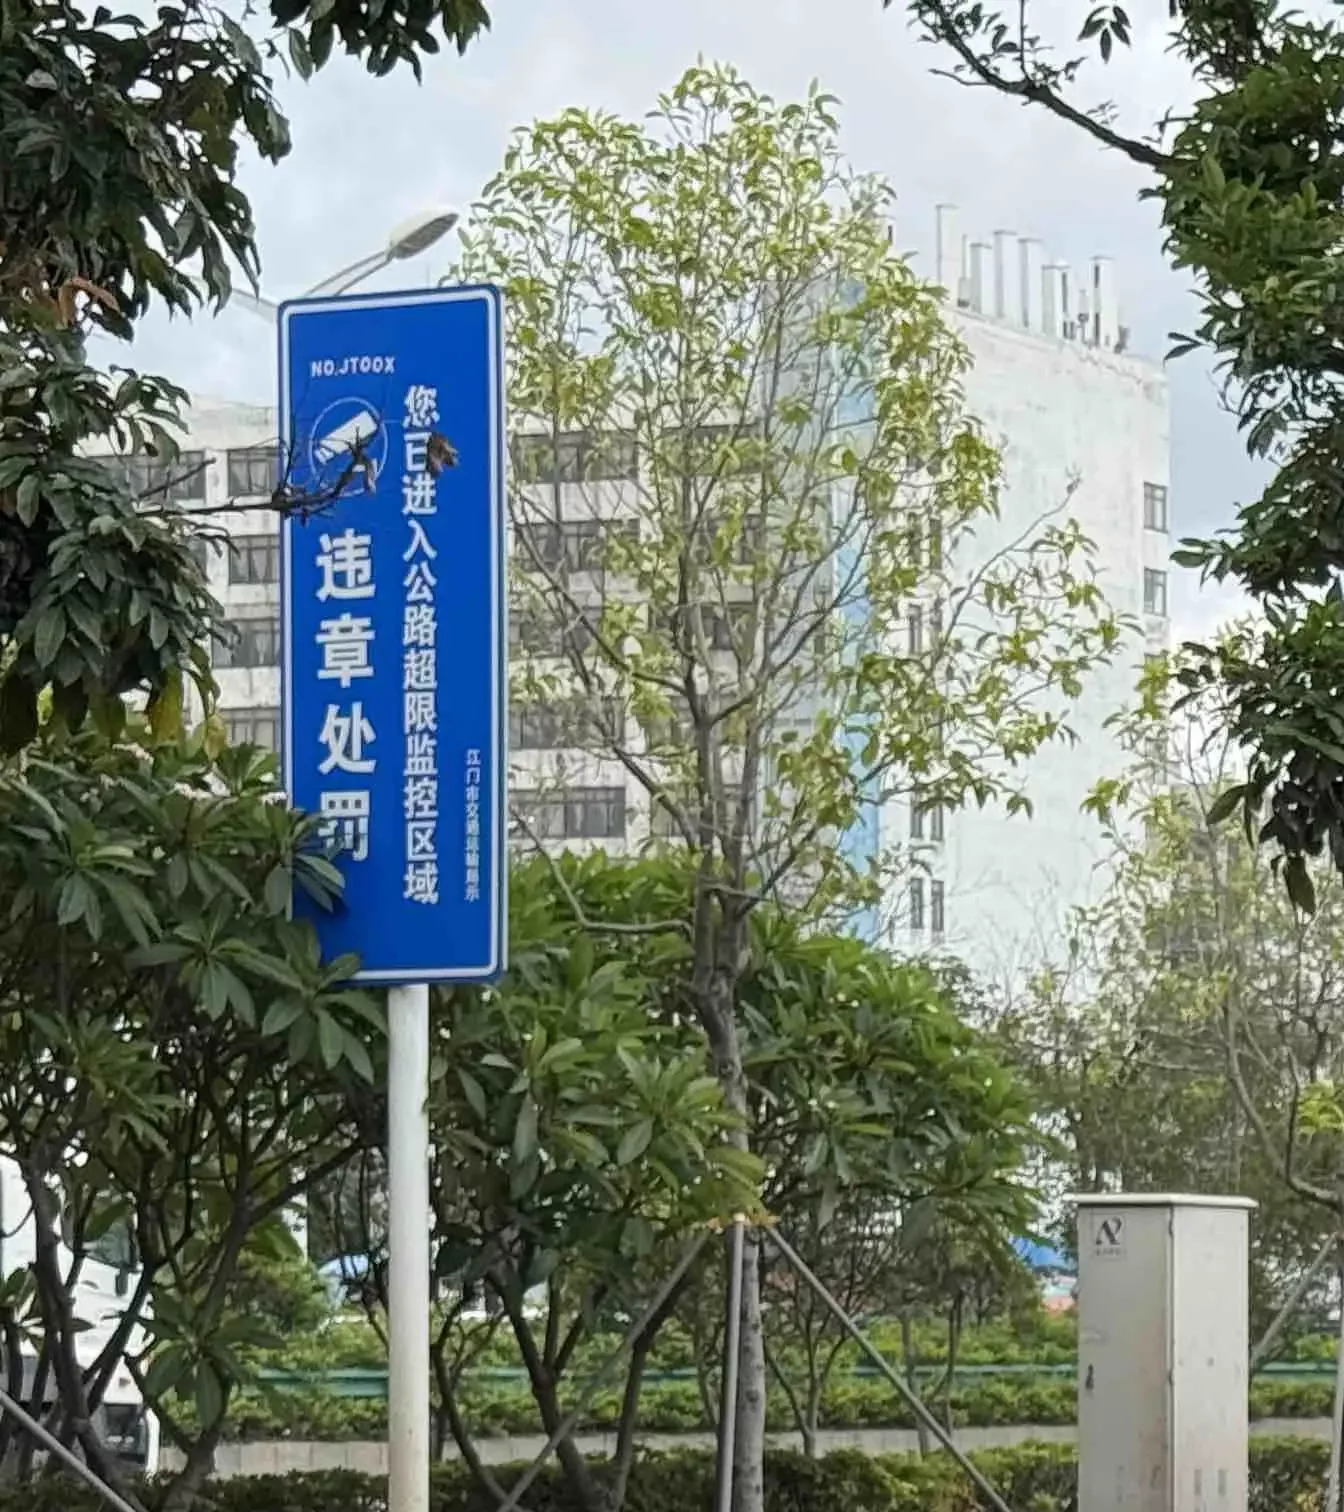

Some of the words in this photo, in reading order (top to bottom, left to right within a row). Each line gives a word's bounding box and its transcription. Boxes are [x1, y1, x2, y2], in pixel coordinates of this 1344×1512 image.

[315, 527, 377, 862] 违章处罚
[402, 384, 440, 905] 您已进入公路超限监控区域
